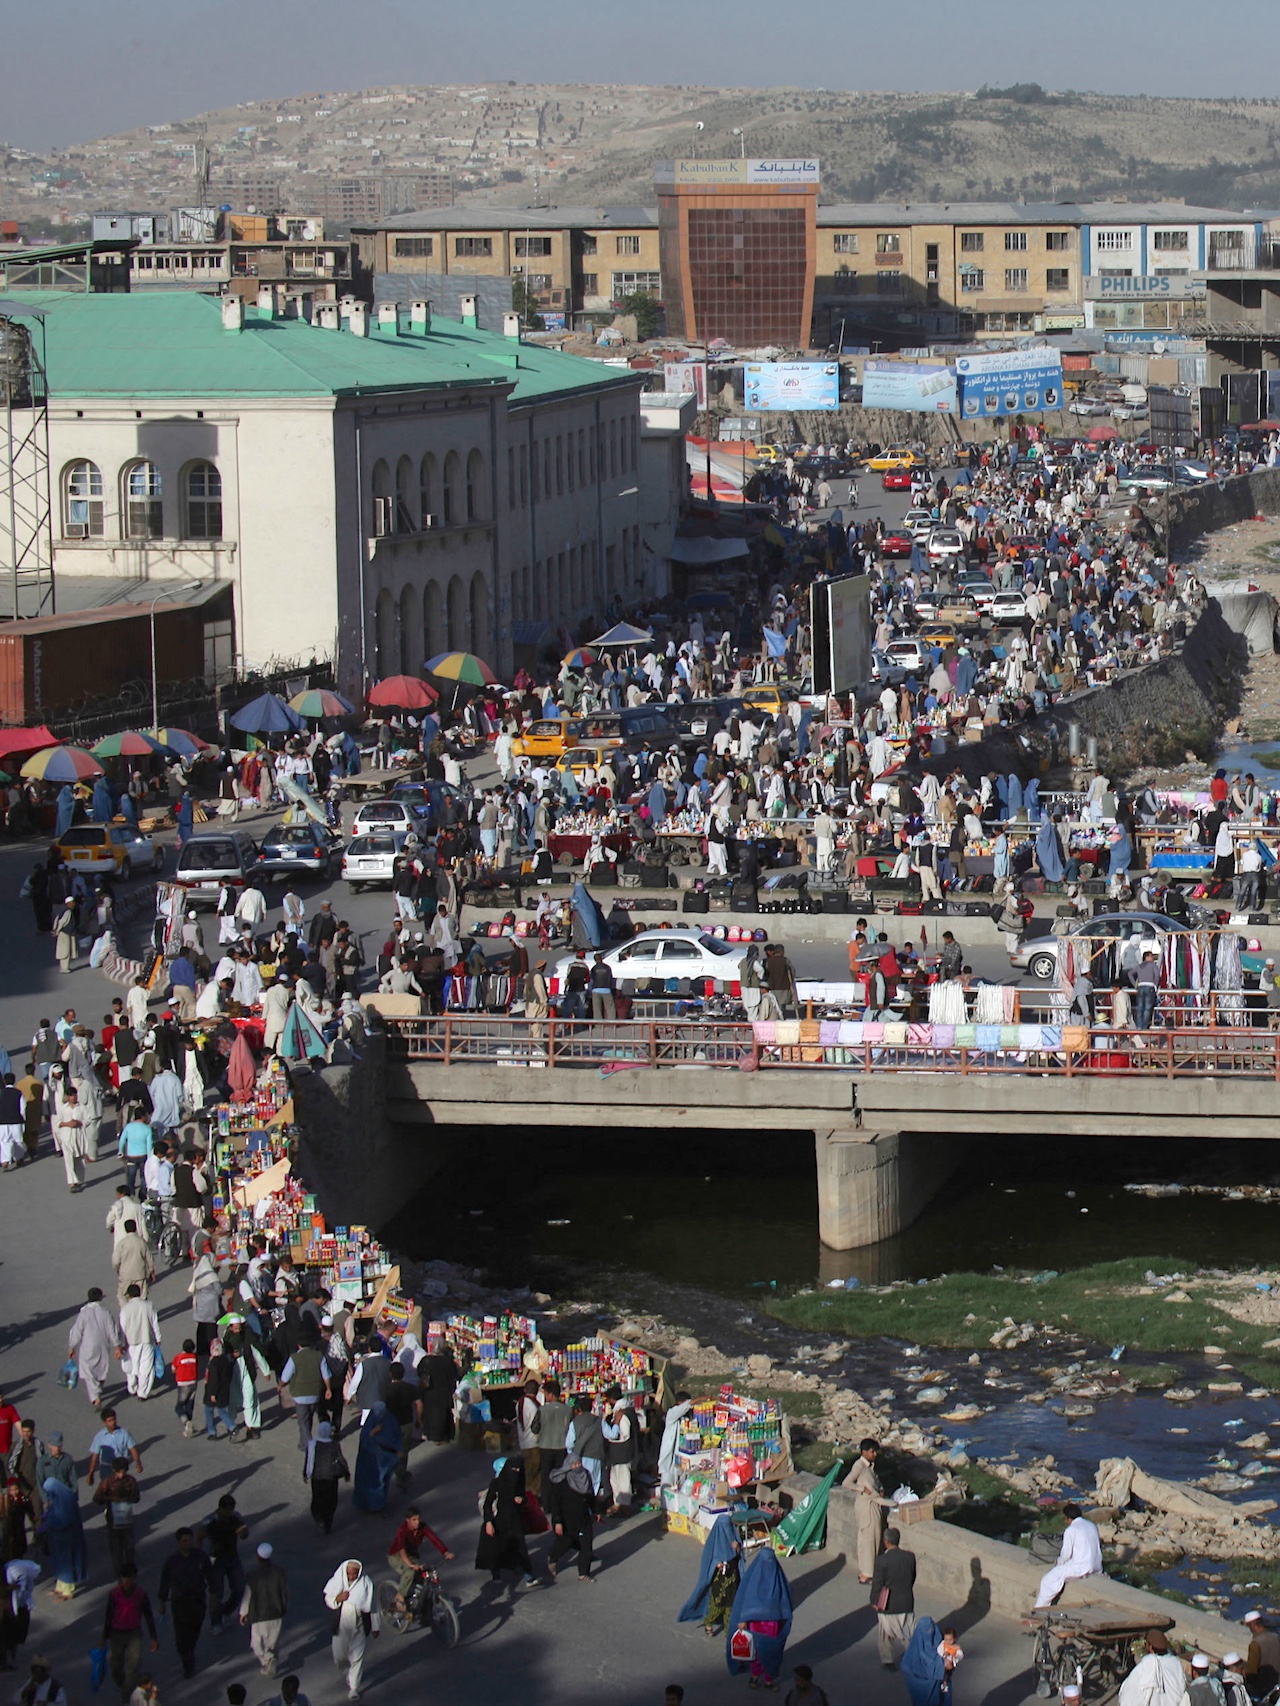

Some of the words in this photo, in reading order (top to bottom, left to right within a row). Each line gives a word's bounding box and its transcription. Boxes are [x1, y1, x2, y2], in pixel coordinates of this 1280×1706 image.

[1101, 277, 1170, 292] PHILIPS
[981, 364, 1004, 372] ARIANA
[1005, 362, 1030, 370] AFGHAN
[1031, 358, 1058, 367] AIRLINES
